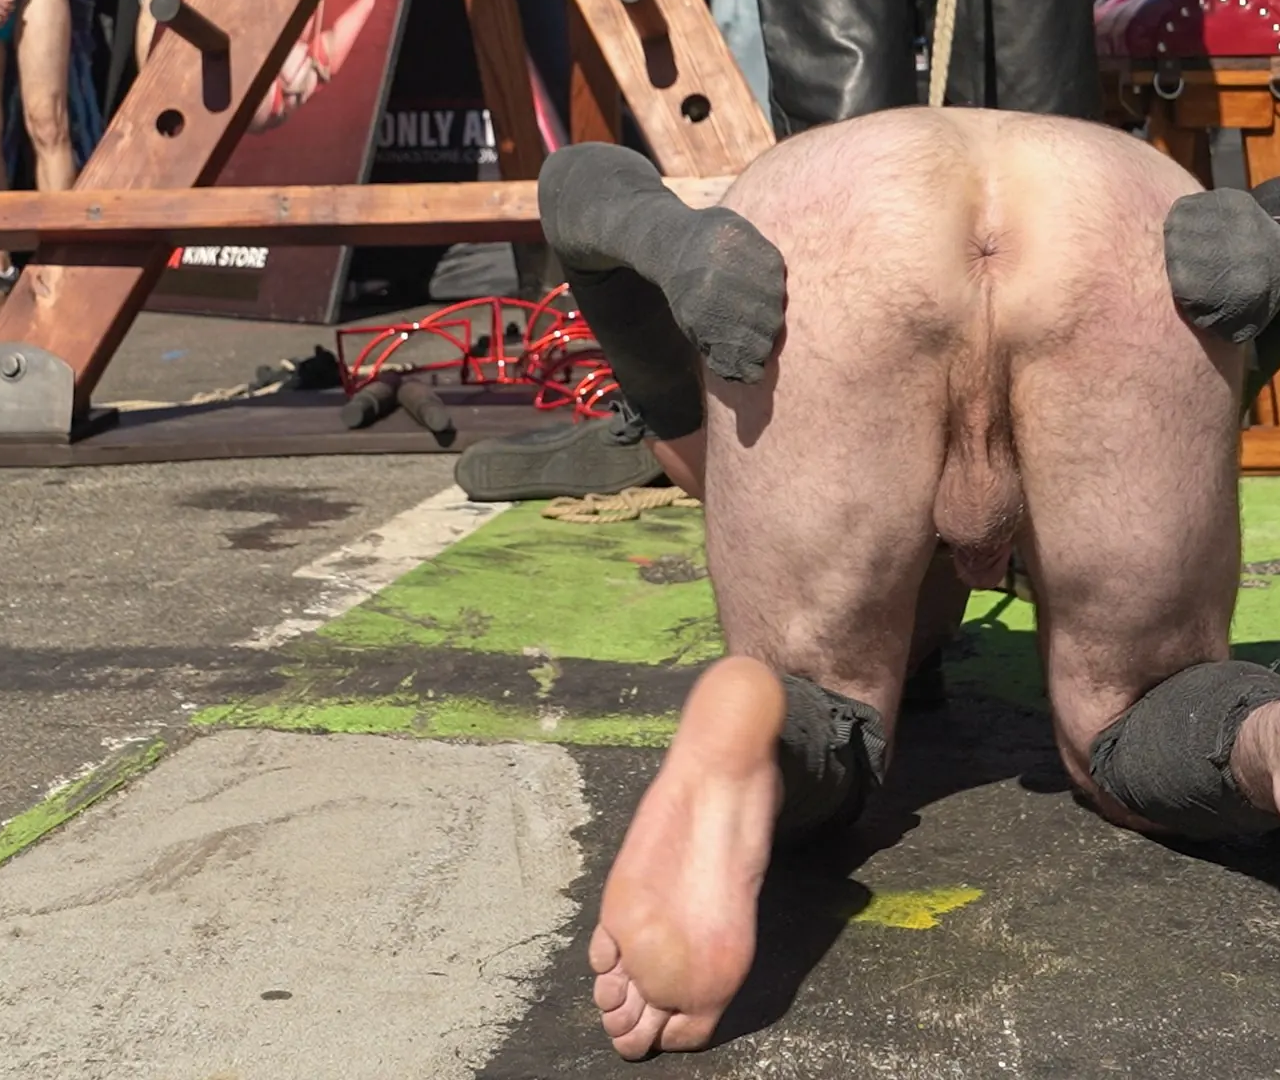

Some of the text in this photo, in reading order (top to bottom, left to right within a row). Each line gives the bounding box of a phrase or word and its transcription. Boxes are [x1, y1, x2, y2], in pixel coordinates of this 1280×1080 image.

[375, 110, 455, 148] ONLY
[182, 246, 269, 268] KINK STORE
